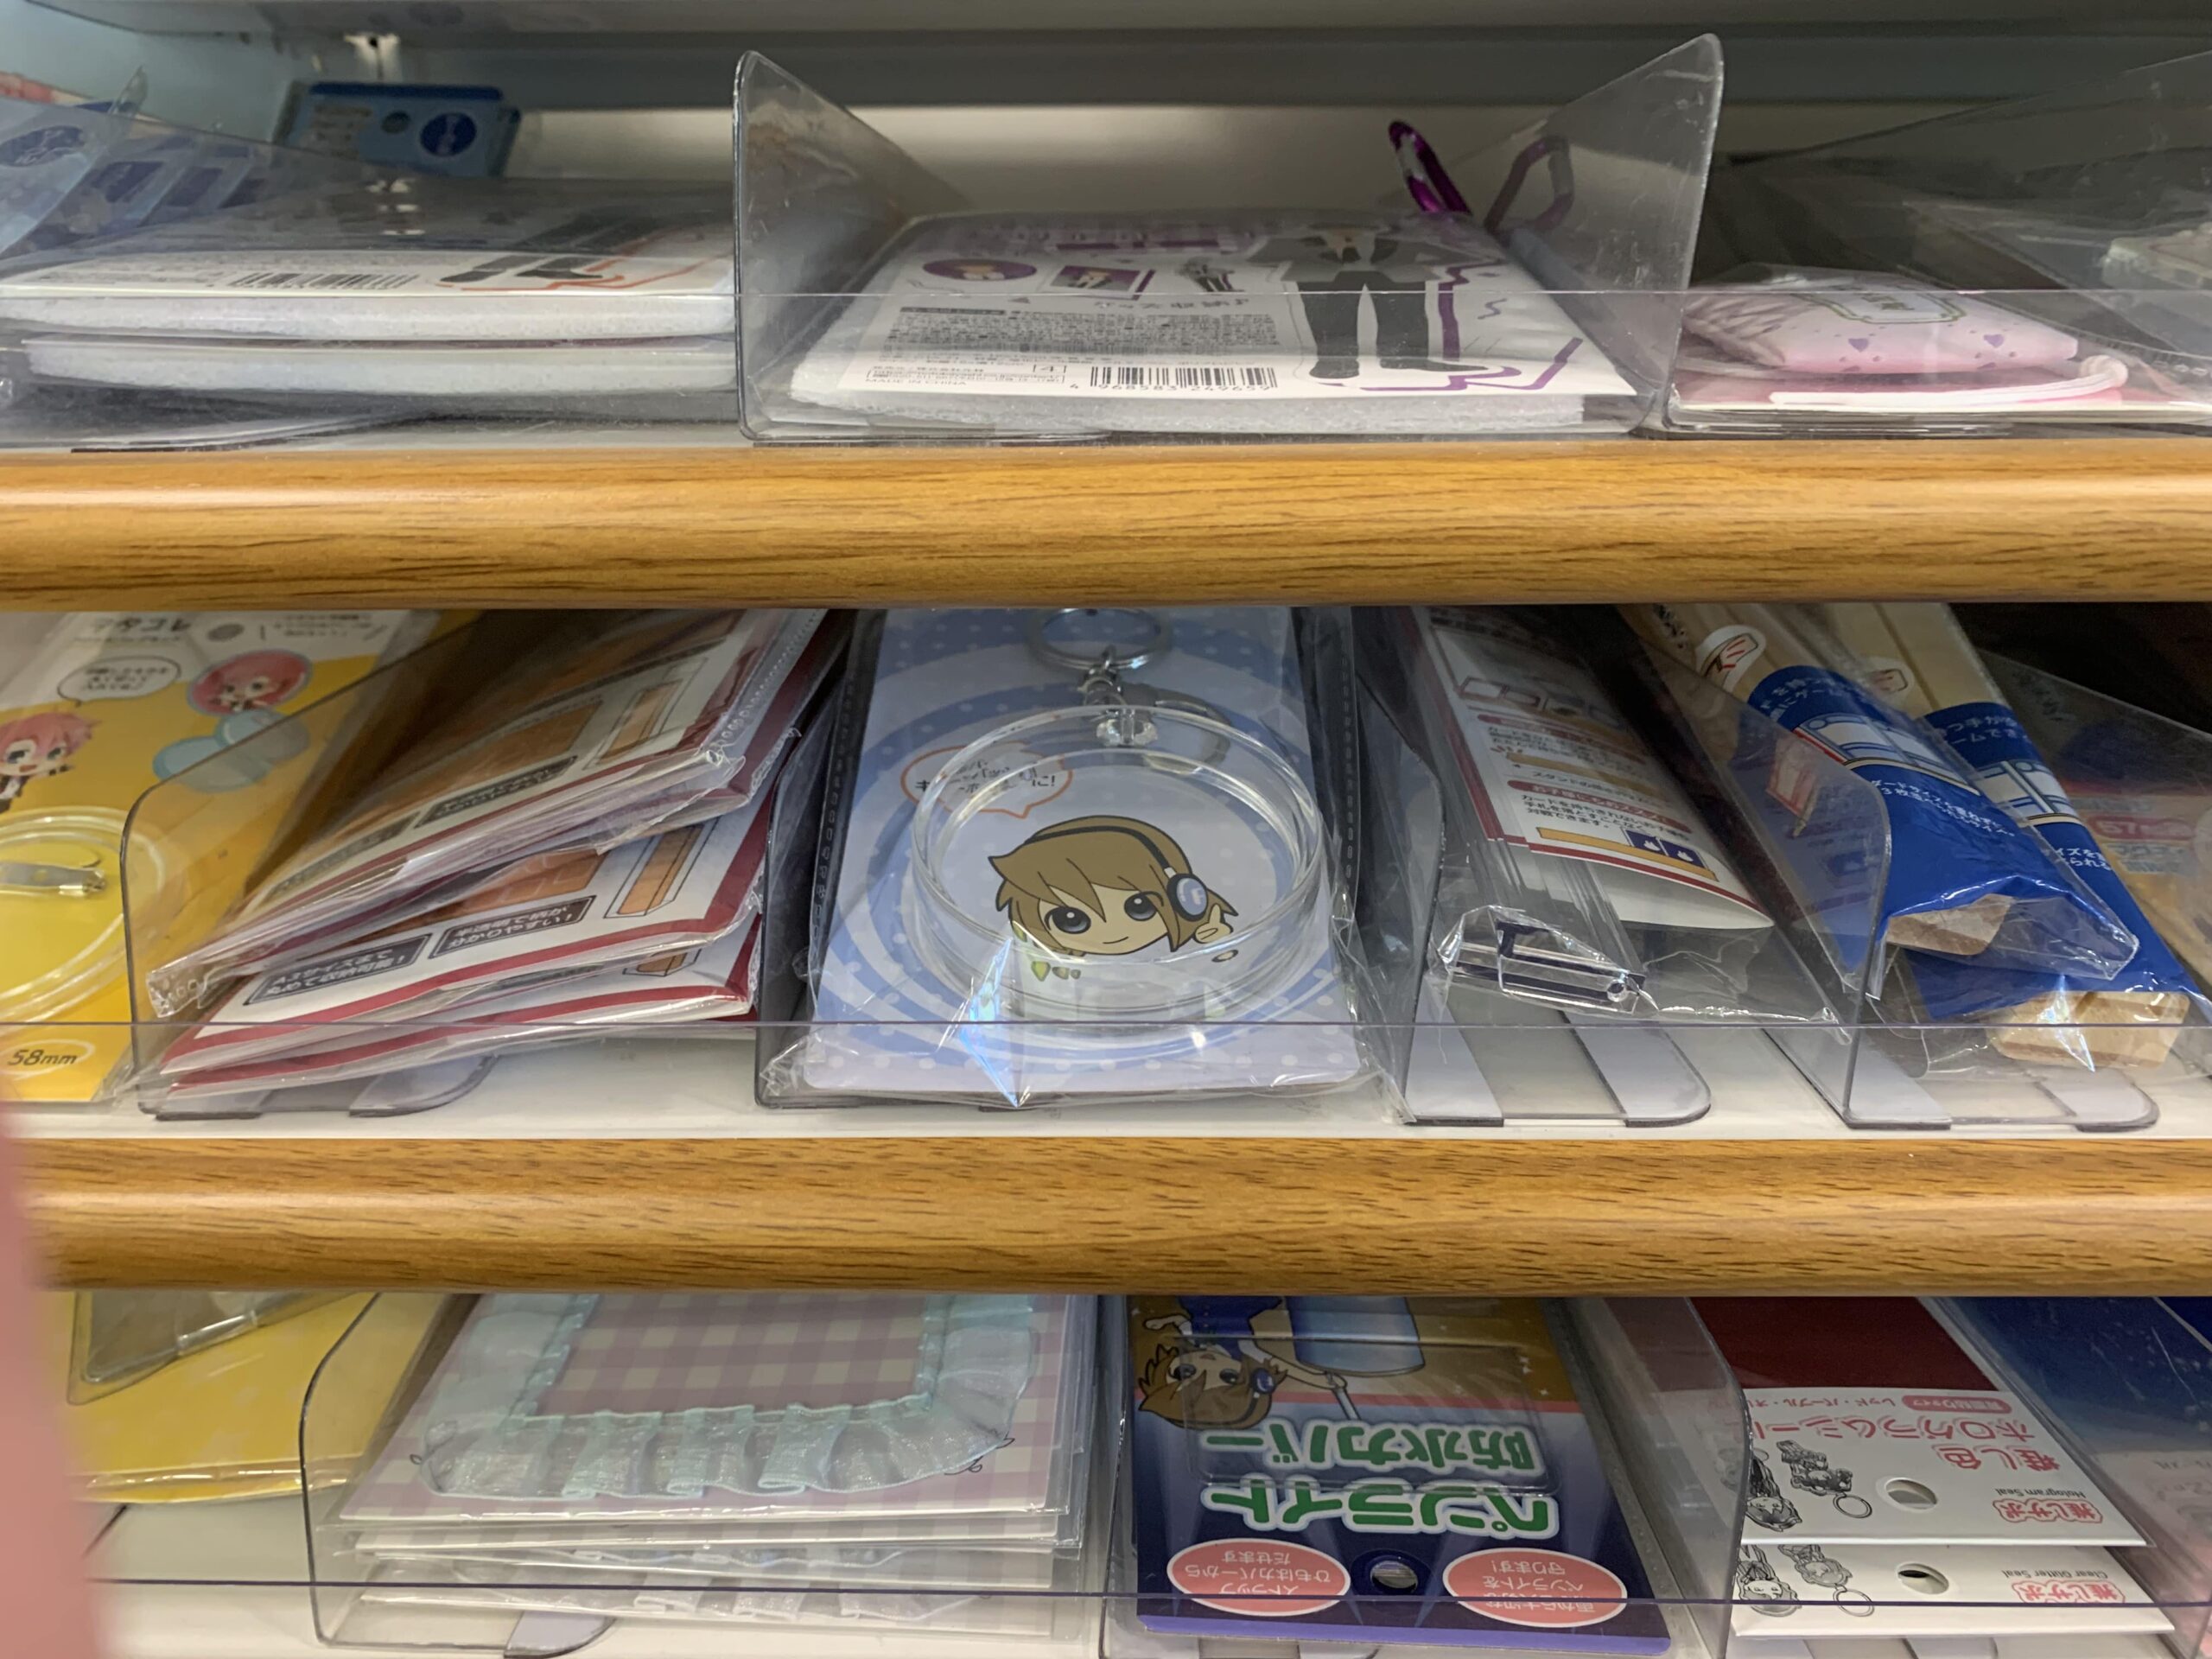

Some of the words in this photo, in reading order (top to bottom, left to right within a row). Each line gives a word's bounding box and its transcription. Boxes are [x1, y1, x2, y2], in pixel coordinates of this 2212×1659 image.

[7, 1049, 78, 1065] 58mm
[1205, 1422, 1537, 1471] 防水カバー
[1937, 1446, 2061, 1470] 推し色
[1994, 1488, 2025, 1497] Seal
[2025, 1489, 2087, 1499] Hologram
[1208, 1478, 1551, 1534] ペンライト
[1998, 1501, 2096, 1520] 推しサポ
[1222, 1550, 1291, 1565] だせます
[1185, 1564, 1332, 1583] ひもはカバーから
[1491, 1560, 1566, 1576] 守ります!
[2001, 1569, 2031, 1579] Seal
[2034, 1570, 2073, 1580] Glitter
[2075, 1570, 2108, 1580] Clear
[1481, 1575, 1585, 1592] ペンライトを
[2018, 1583, 2118, 1601] 推しサポ
